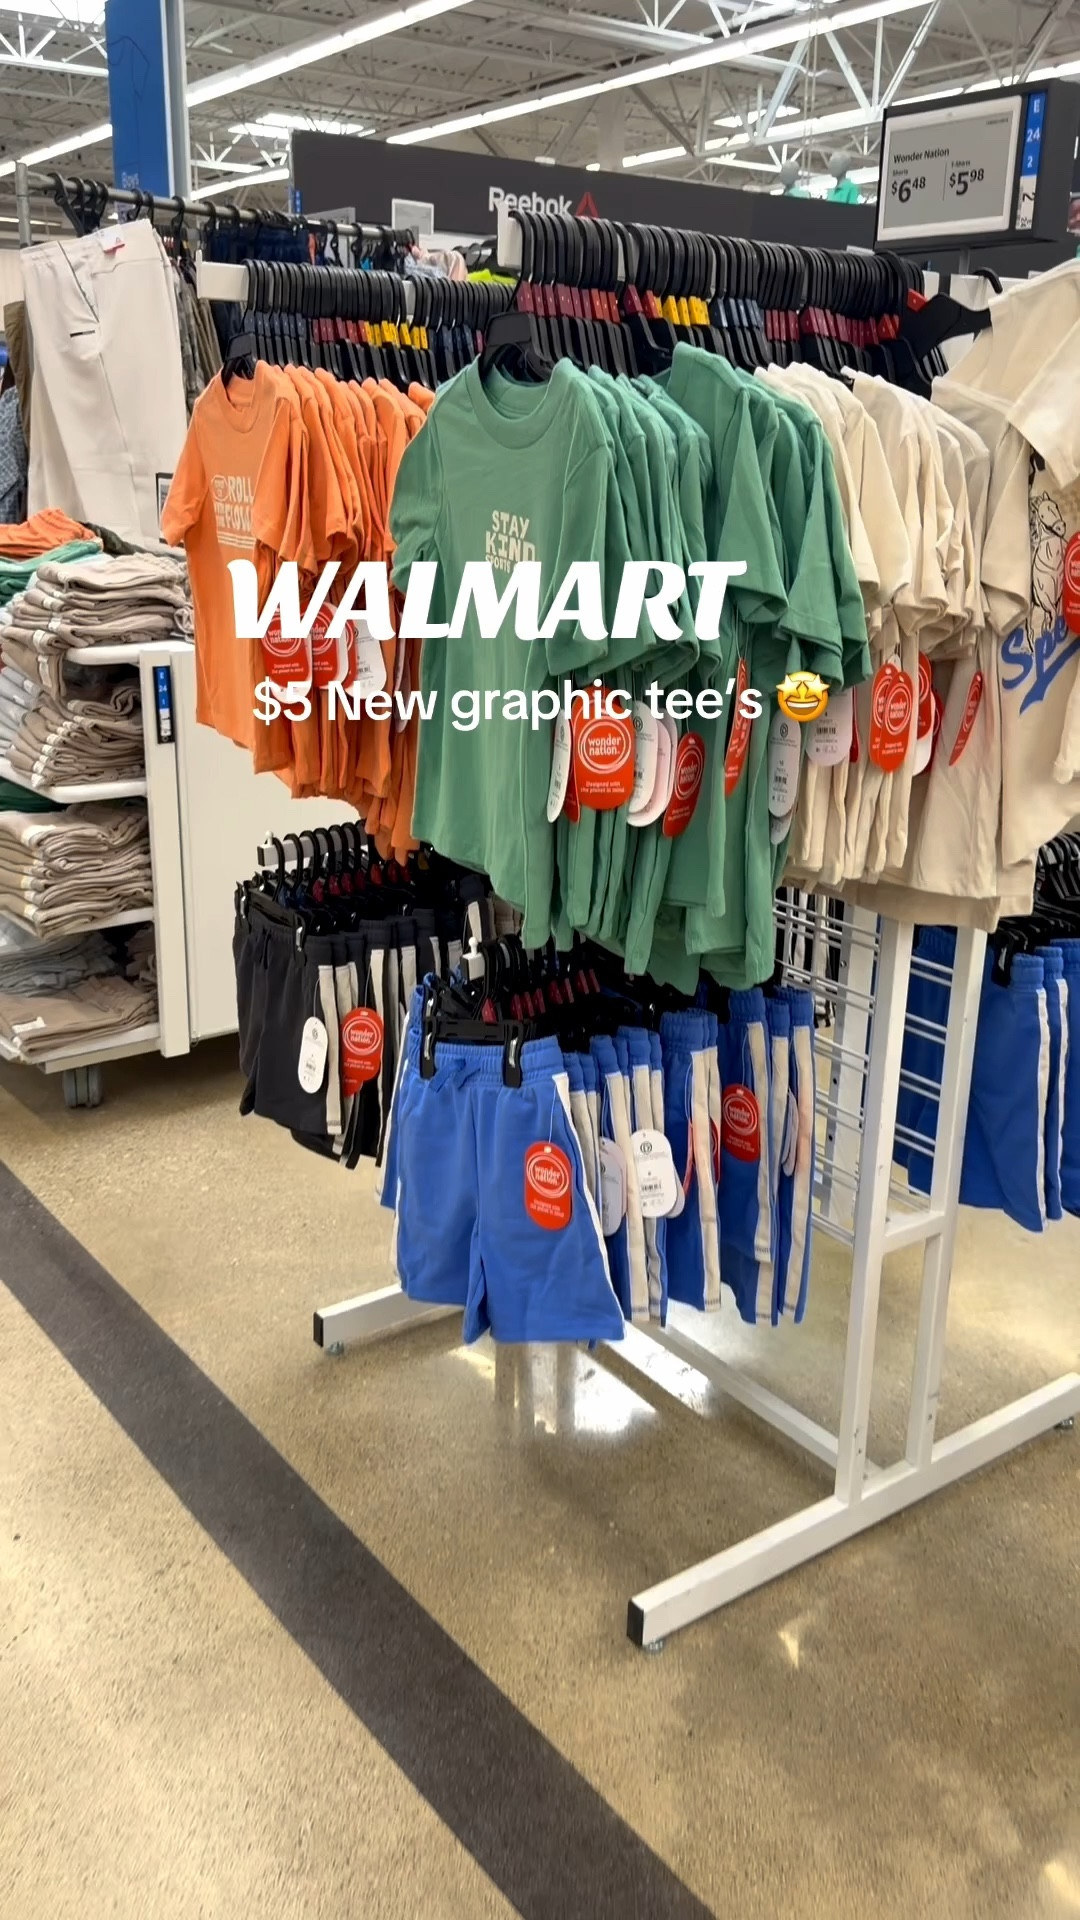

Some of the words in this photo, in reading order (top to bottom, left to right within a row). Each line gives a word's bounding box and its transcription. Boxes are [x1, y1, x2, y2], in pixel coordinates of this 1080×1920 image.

[1033, 100, 1040, 113] E
[1026, 127, 1041, 143] 24
[893, 152, 923, 164] Wonder
[924, 148, 950, 159] Nation
[1027, 156, 1034, 168] 2
[488, 186, 573, 216] Reebok
[228, 475, 254, 503] ROLL
[491, 509, 530, 539] STAY
[485, 530, 536, 562] KIND
[588, 733, 622, 747] wonder
